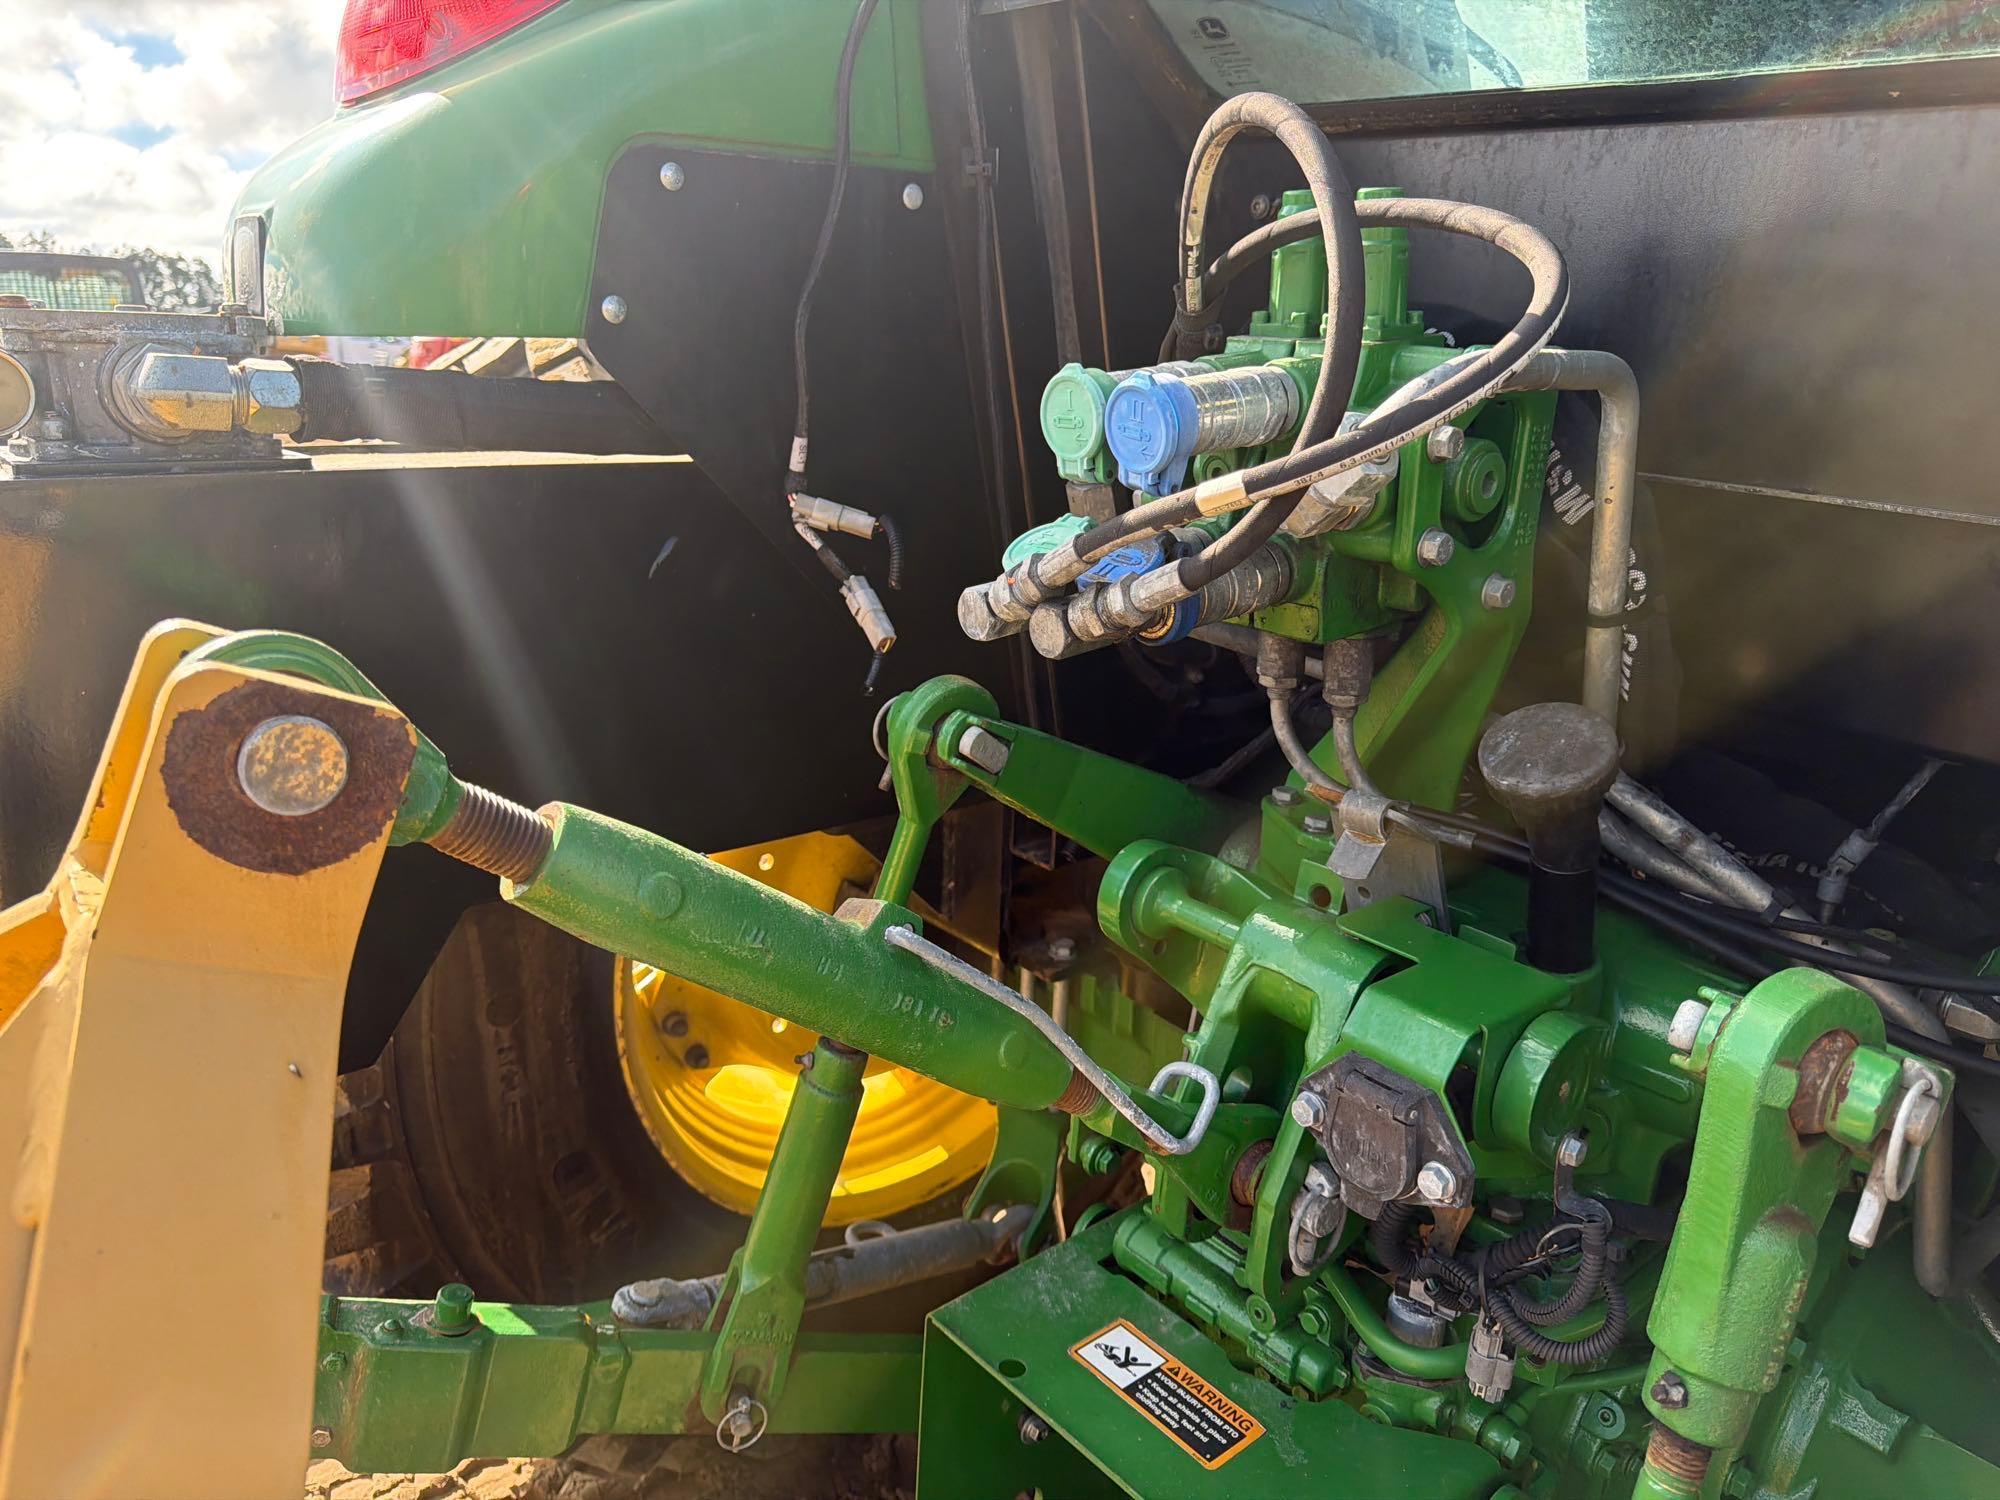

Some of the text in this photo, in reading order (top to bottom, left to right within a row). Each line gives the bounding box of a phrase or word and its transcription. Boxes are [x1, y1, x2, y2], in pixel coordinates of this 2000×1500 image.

[1360, 448, 1382, 461] mm
[1135, 1391, 1180, 1429] clothing away
[1142, 1387, 1210, 1443] Keep hands, feet and
[1151, 1381, 1227, 1445] Keep all shields in place
[1155, 1372, 1239, 1439] AVOID INJURY FROM PTO
[1181, 1372, 1254, 1432] WARNING
